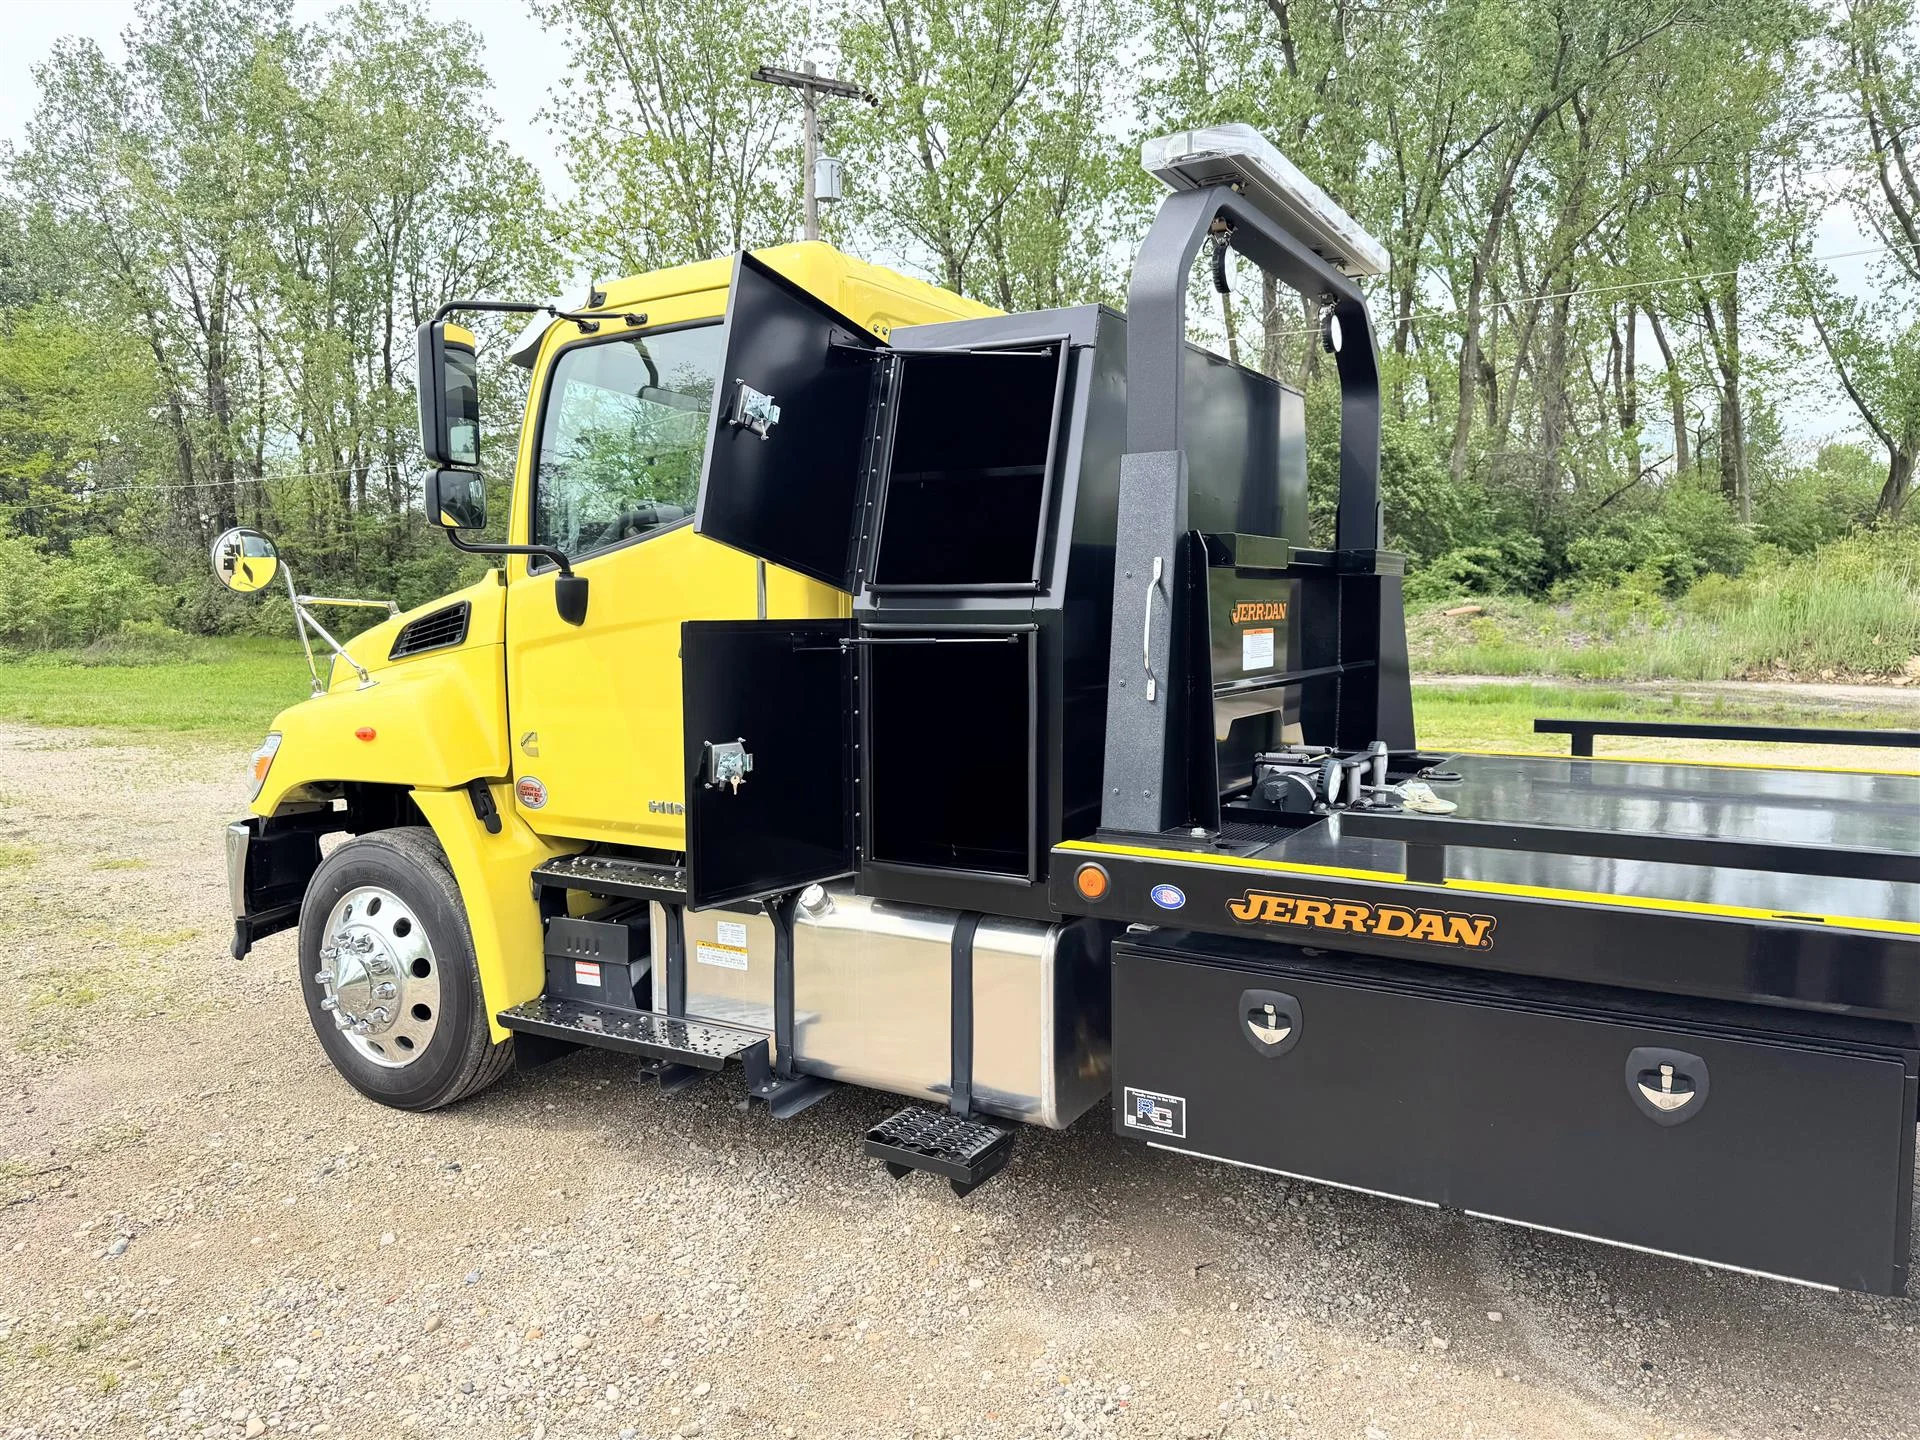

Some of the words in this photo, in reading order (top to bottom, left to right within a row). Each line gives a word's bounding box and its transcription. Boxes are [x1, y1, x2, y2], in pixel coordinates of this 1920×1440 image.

[1232, 602, 1286, 624] JERR-DAN
[648, 800, 685, 815] HIN
[1229, 894, 1491, 947] JERR-DAN
